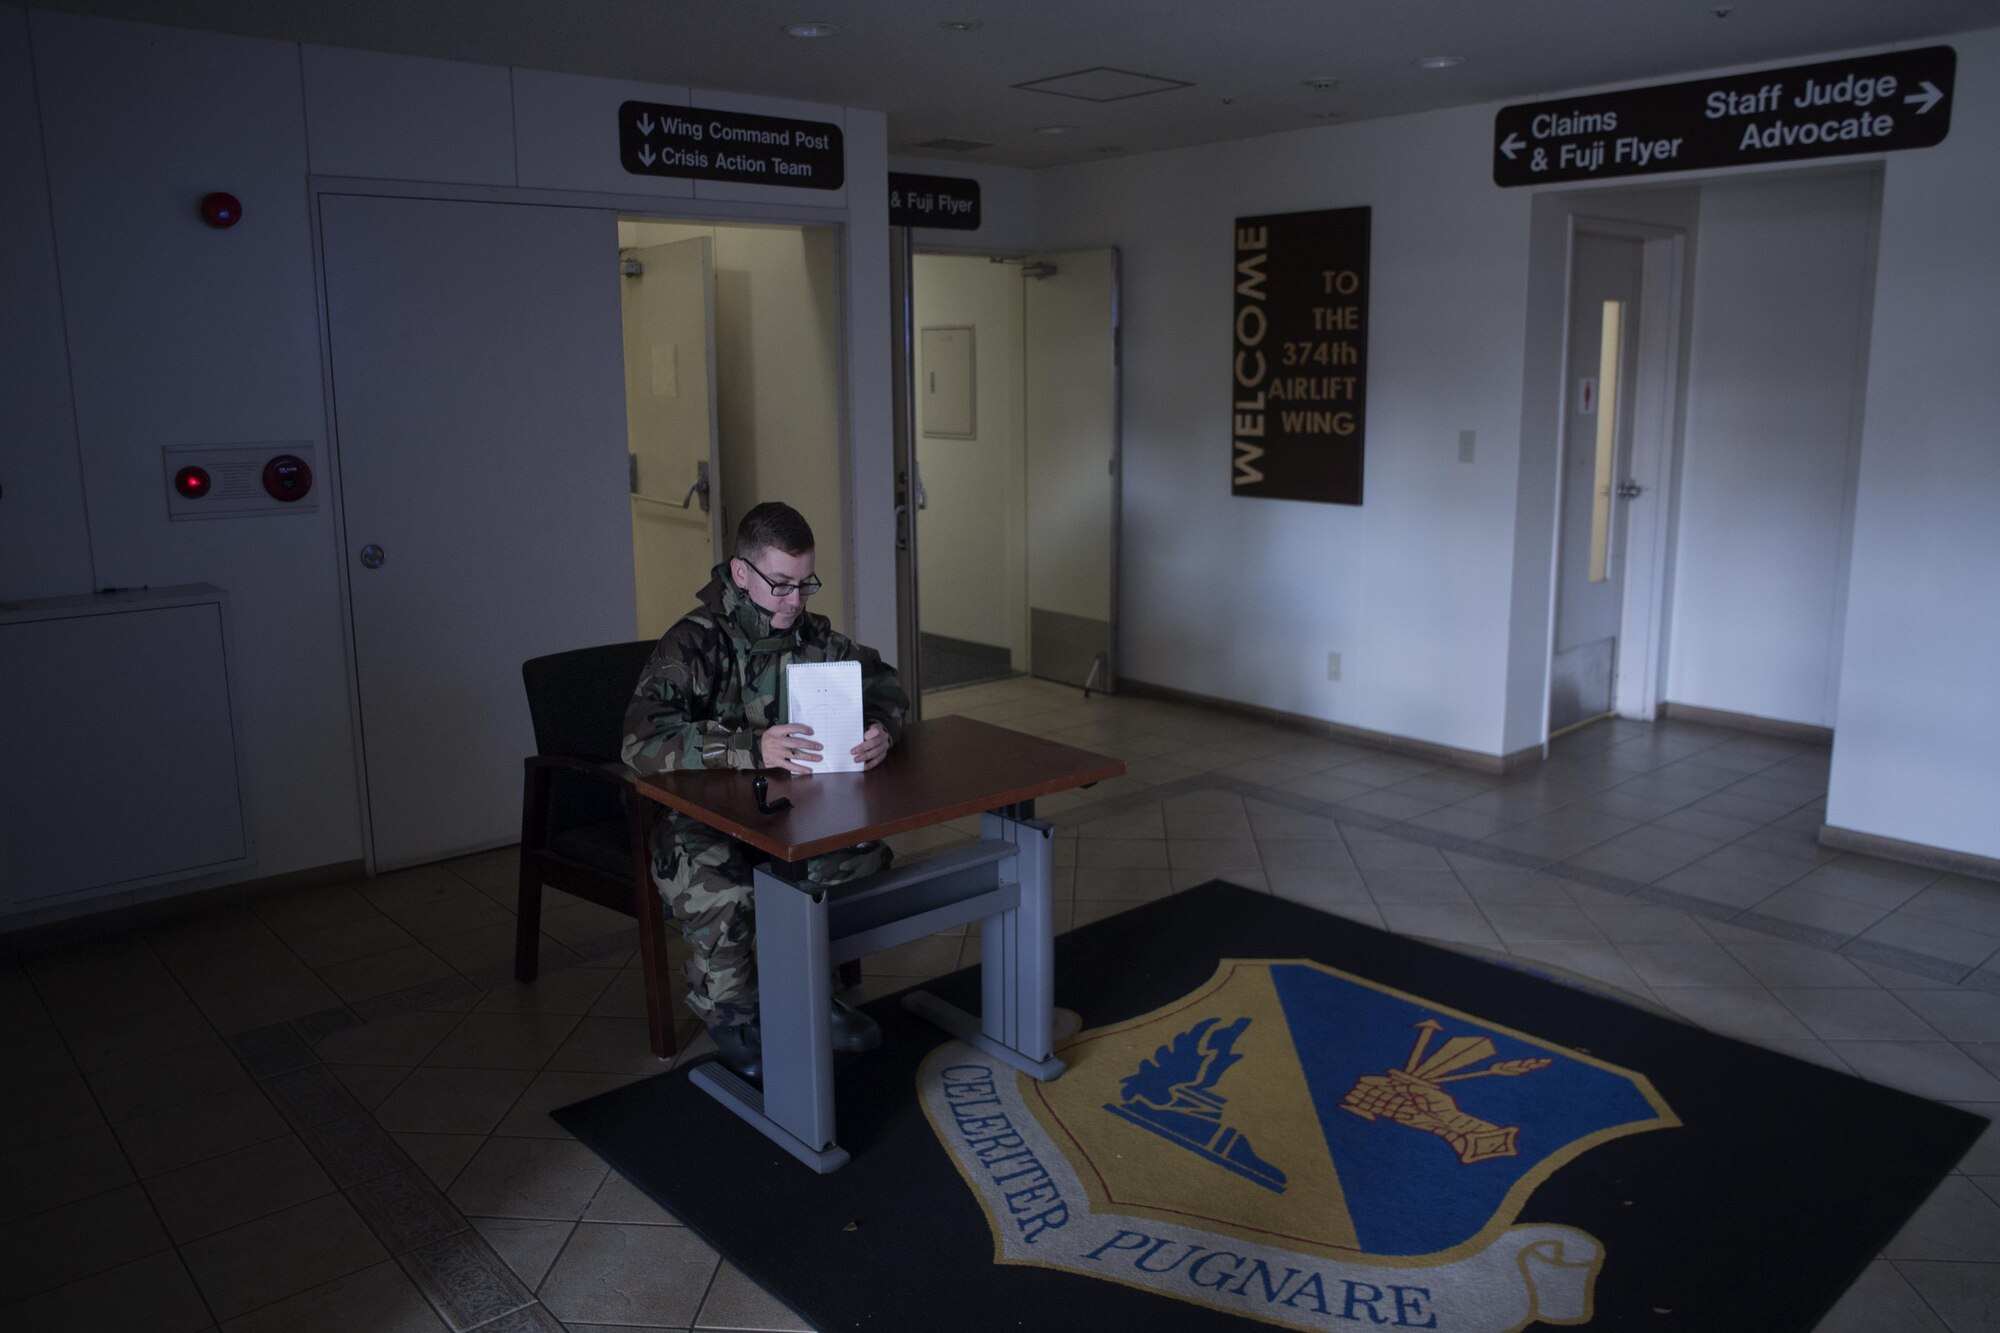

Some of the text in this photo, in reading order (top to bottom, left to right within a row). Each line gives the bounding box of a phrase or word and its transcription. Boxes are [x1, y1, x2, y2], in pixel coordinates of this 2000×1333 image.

[1705, 73, 1898, 119] Staff Judge
[660, 116, 829, 151] Wing Command Post
[1531, 111, 1617, 140] Claims
[1739, 114, 1894, 151] Advocate
[662, 147, 812, 177] Crisis Action Team
[1530, 135, 1682, 172] & Fuji Flyer
[890, 191, 973, 214] & Fuji Flyer
[1322, 271, 1359, 295] TO
[1313, 307, 1359, 331] THE
[1234, 226, 1268, 486] WELCOME
[1281, 342, 1357, 366] 374th
[1267, 377, 1357, 401] AIRLIFT
[1281, 411, 1356, 436] WING
[941, 1064, 1070, 1245] CELERITER
[1081, 1229, 1438, 1330] PUGNARE
